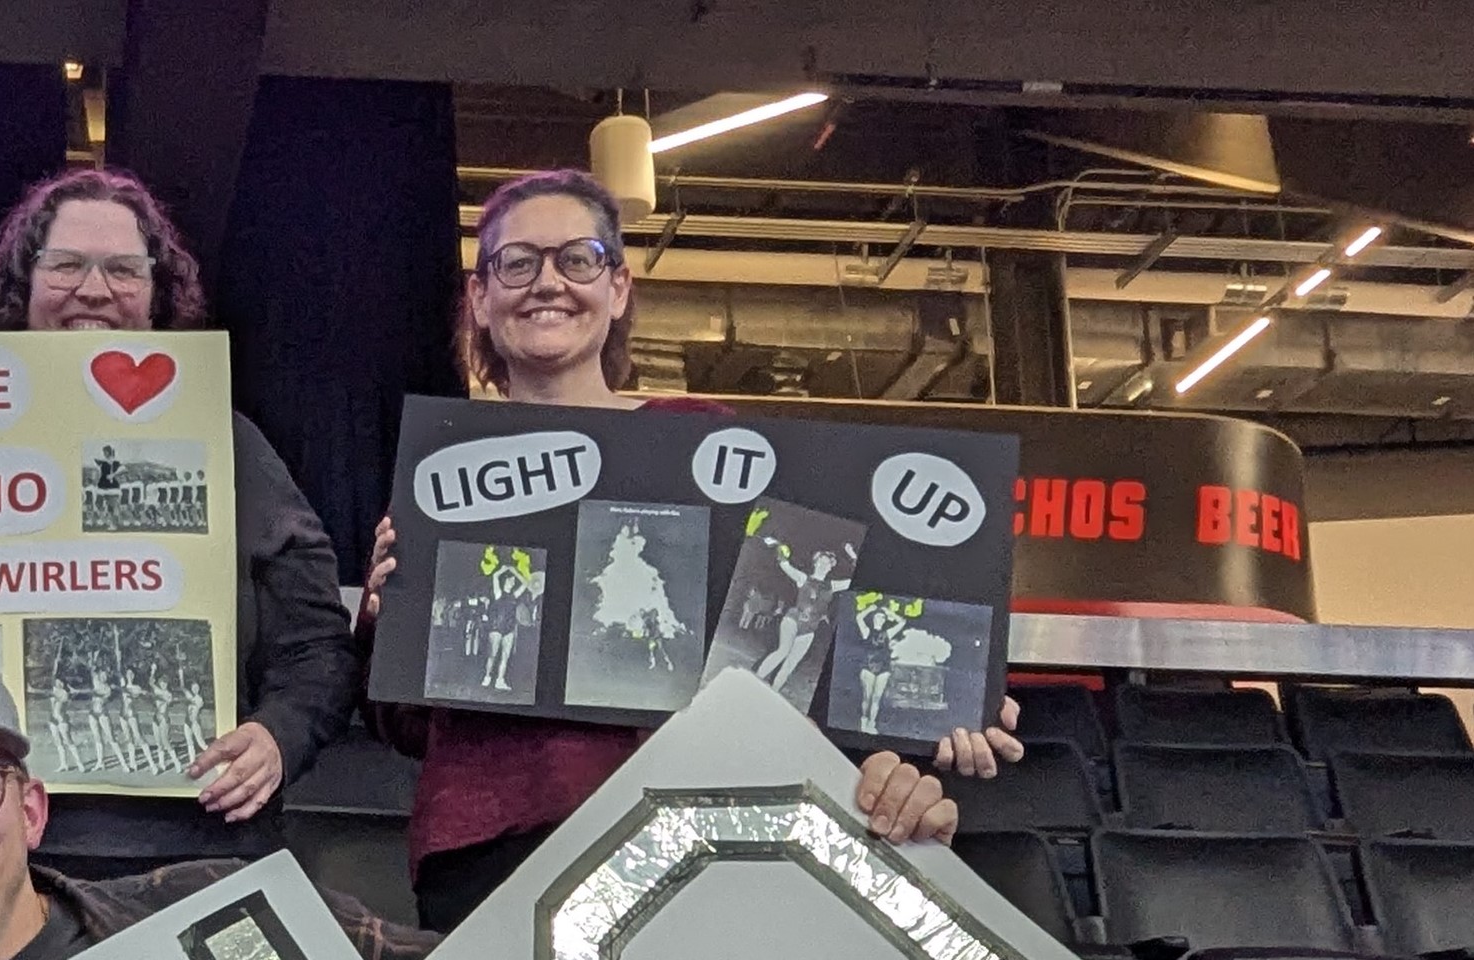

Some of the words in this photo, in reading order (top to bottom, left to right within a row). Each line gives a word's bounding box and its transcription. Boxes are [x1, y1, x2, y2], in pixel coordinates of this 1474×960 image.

[430, 445, 587, 512] LIGHT
[712, 445, 766, 490] IT
[891, 468, 971, 529] UP
[1197, 484, 1301, 561] BEER
